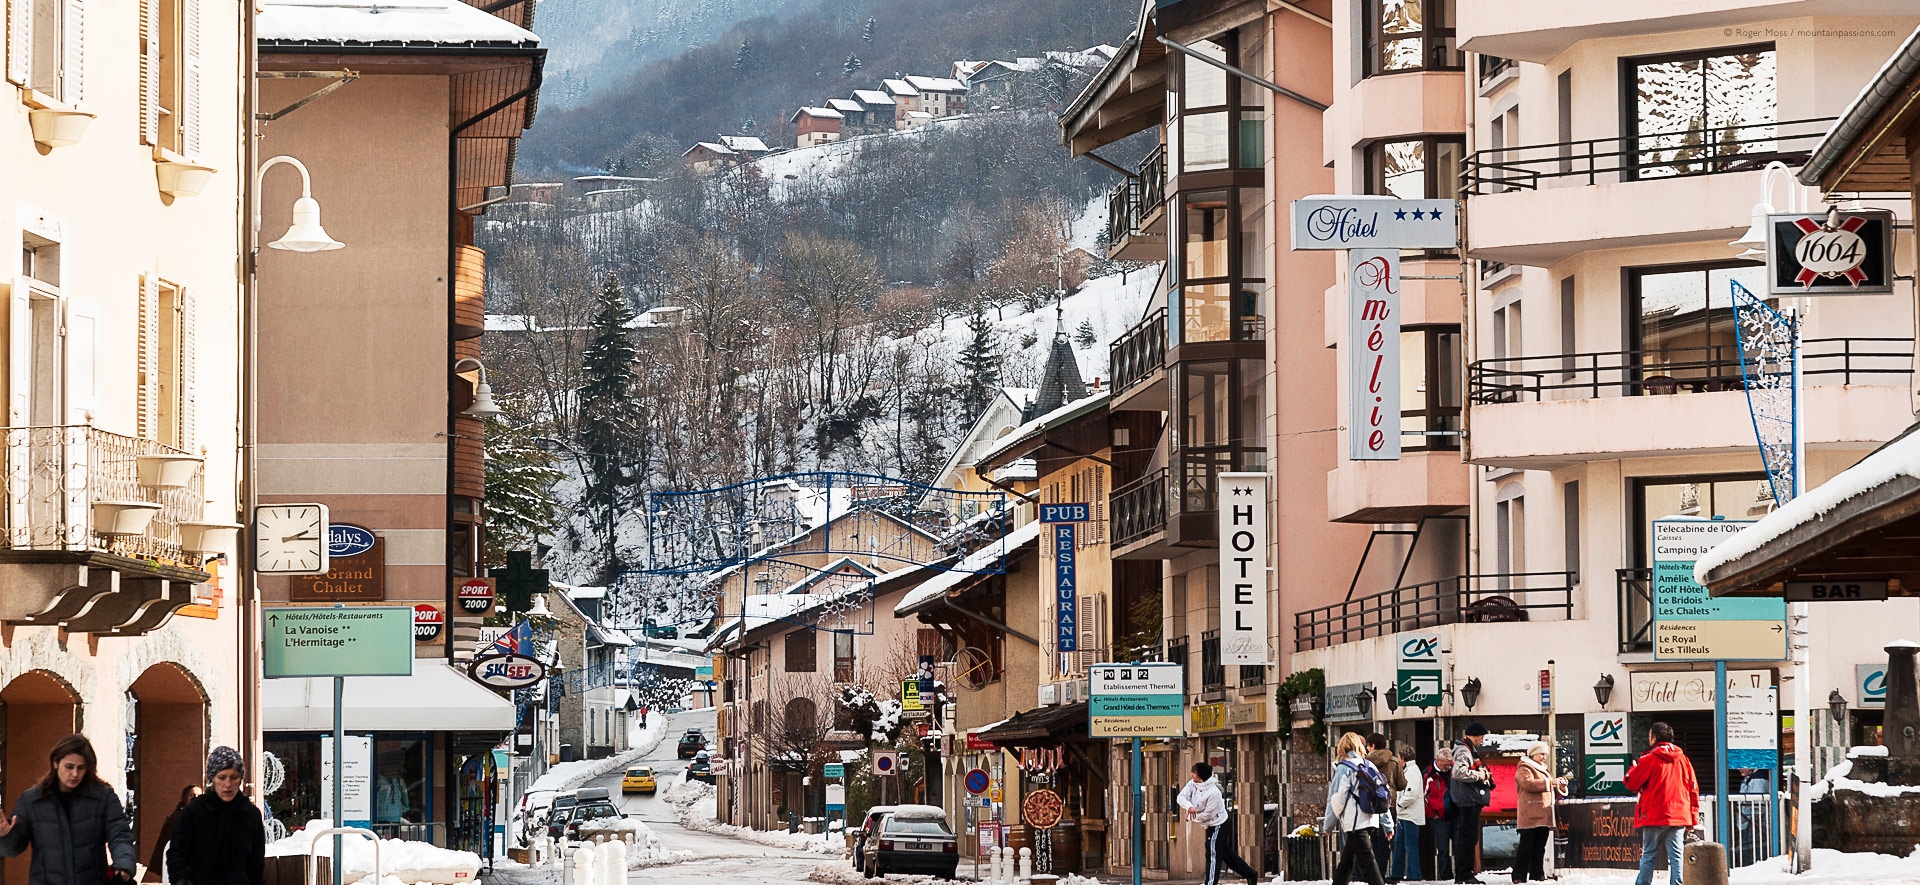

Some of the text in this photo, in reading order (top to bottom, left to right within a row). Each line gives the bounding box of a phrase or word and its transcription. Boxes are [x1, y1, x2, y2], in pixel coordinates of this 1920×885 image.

[1801, 235, 1862, 264] 1664
[1354, 256, 1398, 451] Amélie
[1046, 506, 1084, 520] PUB
[1658, 546, 1698, 555] Camping
[1232, 505, 1254, 630] HOTEL
[326, 568, 373, 580] Grand
[1658, 574, 1689, 582] Amélie
[313, 581, 363, 592] Chalet
[460, 586, 488, 594] SPORT
[1058, 528, 1074, 648] RESTAURANT
[1658, 585, 1704, 594] Golf Hôtel
[1812, 584, 1861, 598] BAR
[465, 600, 488, 608] 2000
[1672, 596, 1702, 604] Bridois
[1676, 606, 1710, 614] Chalets
[286, 612, 383, 620] Hôtels/Hôtels-Restaurants
[415, 611, 438, 620] PORT
[285, 625, 339, 634] La Vanoise
[285, 638, 345, 648] L'Hermitage
[1672, 636, 1696, 644] Royal
[1402, 637, 1438, 658] CA
[1104, 670, 1148, 678] P0 P1 P2
[1590, 718, 1622, 740] CA
